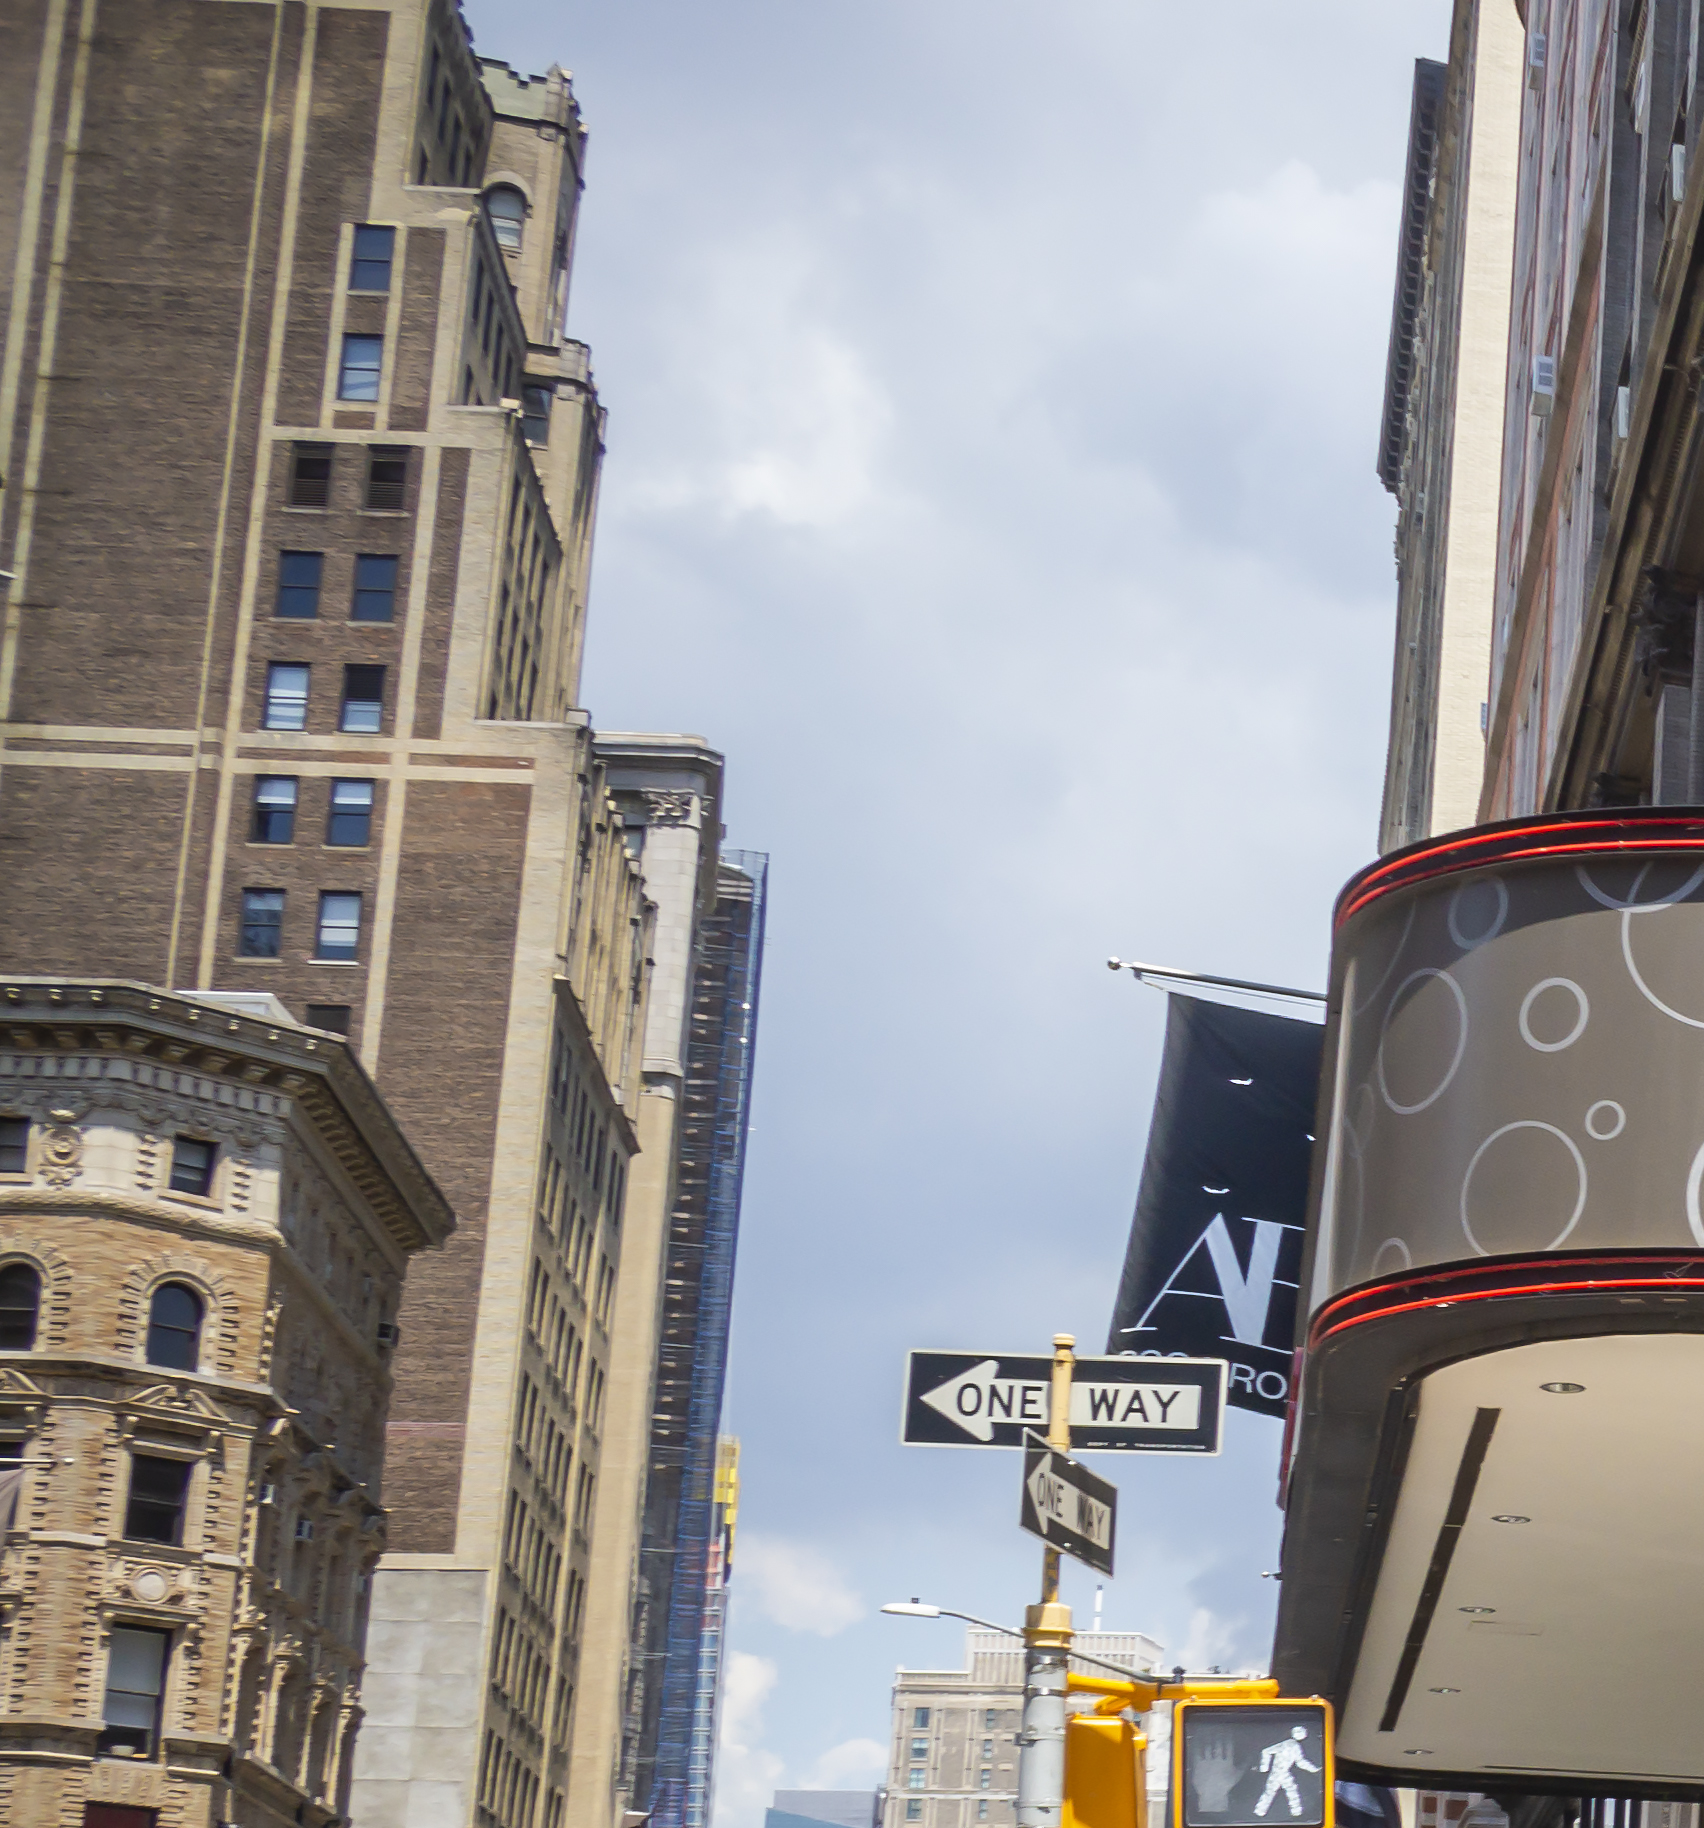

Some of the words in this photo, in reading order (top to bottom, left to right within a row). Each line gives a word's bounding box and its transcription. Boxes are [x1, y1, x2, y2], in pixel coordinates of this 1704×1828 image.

[956, 1382, 1044, 1420] ONE
[1089, 1388, 1183, 1425] WAY
[1036, 1472, 1065, 1519] ONE
[1076, 1490, 1107, 1540] WAY
